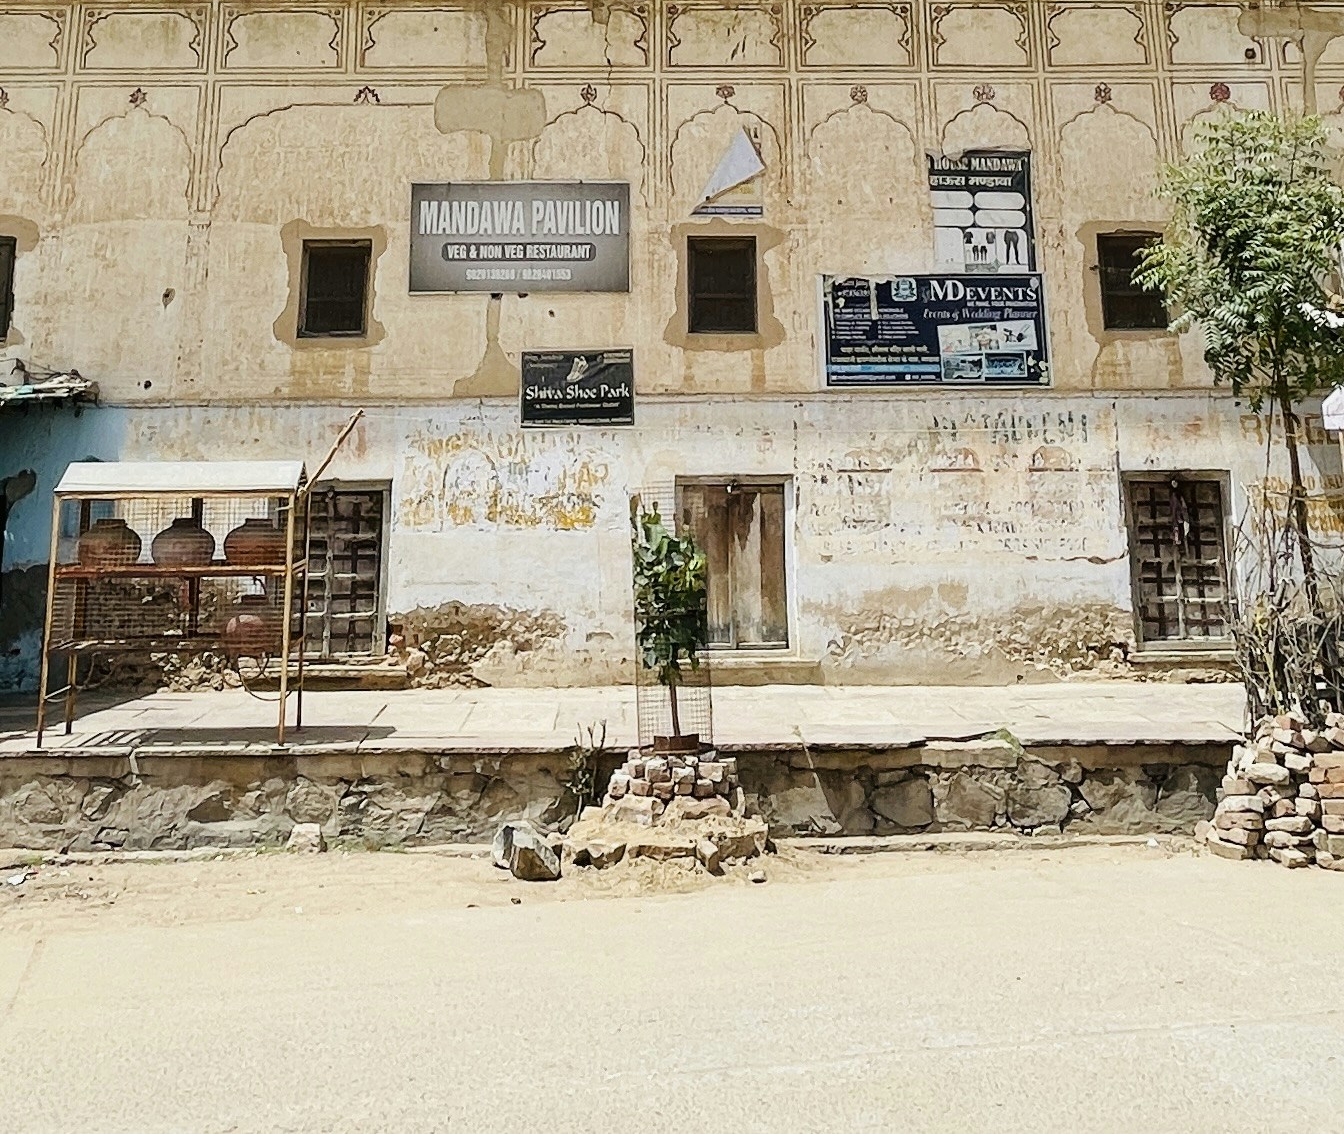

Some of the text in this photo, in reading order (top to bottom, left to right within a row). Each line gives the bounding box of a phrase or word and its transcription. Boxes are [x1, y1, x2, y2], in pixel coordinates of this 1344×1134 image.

[419, 199, 620, 235] MANDAWA PAVILION
[447, 244, 591, 259] VEG & NON VEG RESTAURANT
[923, 308, 951, 319] Events
[961, 307, 1001, 321] Wedding
[1003, 307, 1038, 319] Planner
[525, 382, 630, 400] Shiva Shoe Park
